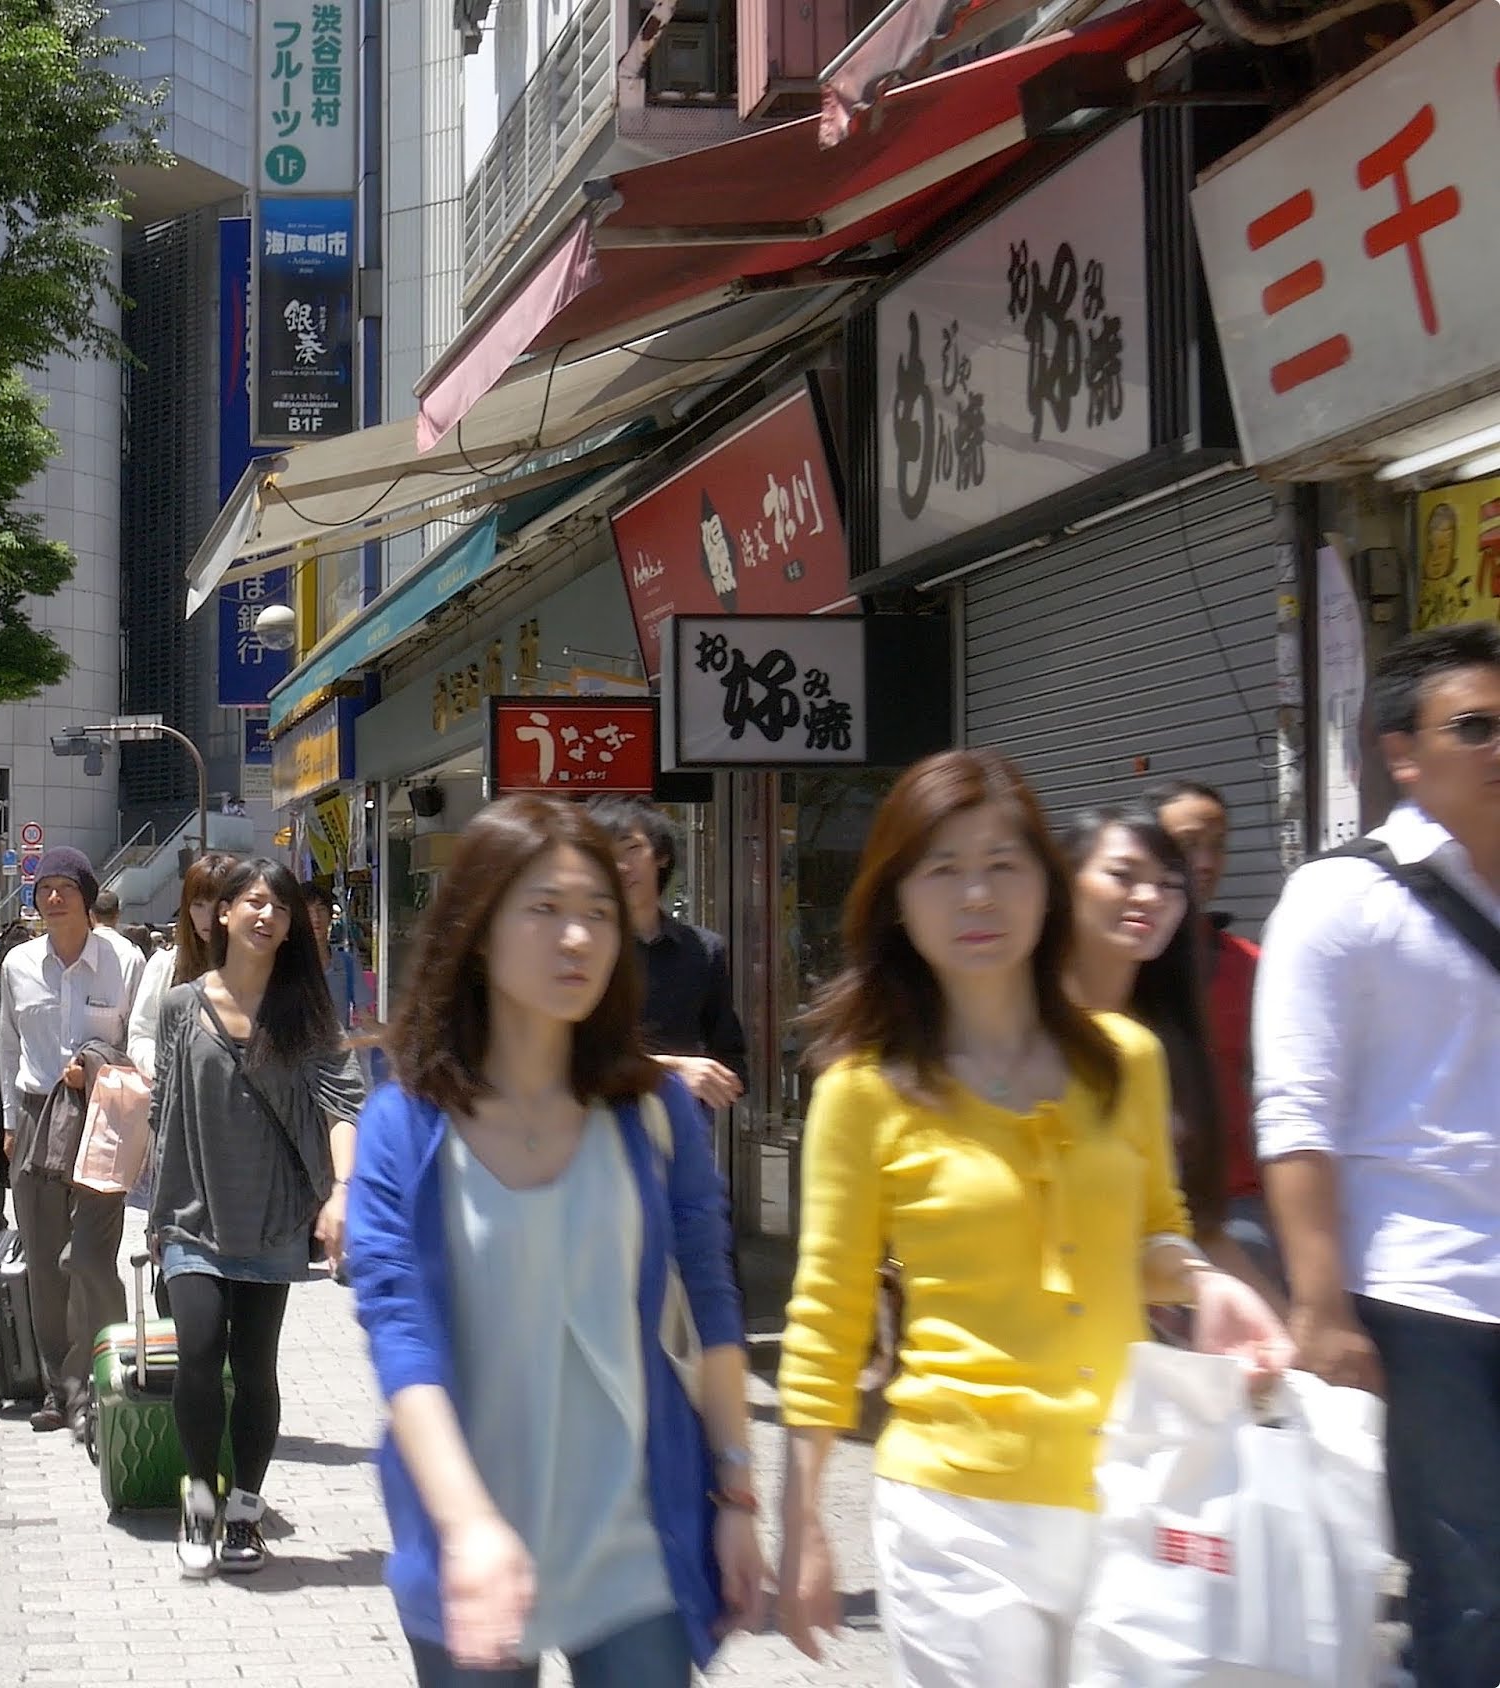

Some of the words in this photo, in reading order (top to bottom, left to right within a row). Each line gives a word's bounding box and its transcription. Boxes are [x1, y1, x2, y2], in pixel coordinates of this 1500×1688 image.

[271, 22, 303, 137] フルーツ
[311, 4, 342, 127] 渋谷西村
[276, 153, 298, 177] 1F
[265, 229, 347, 256] 海底都市
[1246, 60, 1500, 395] 三千
[288, 417, 323, 432] B1F
[695, 631, 854, 751] お好み焼
[516, 712, 636, 784] うなぎ
